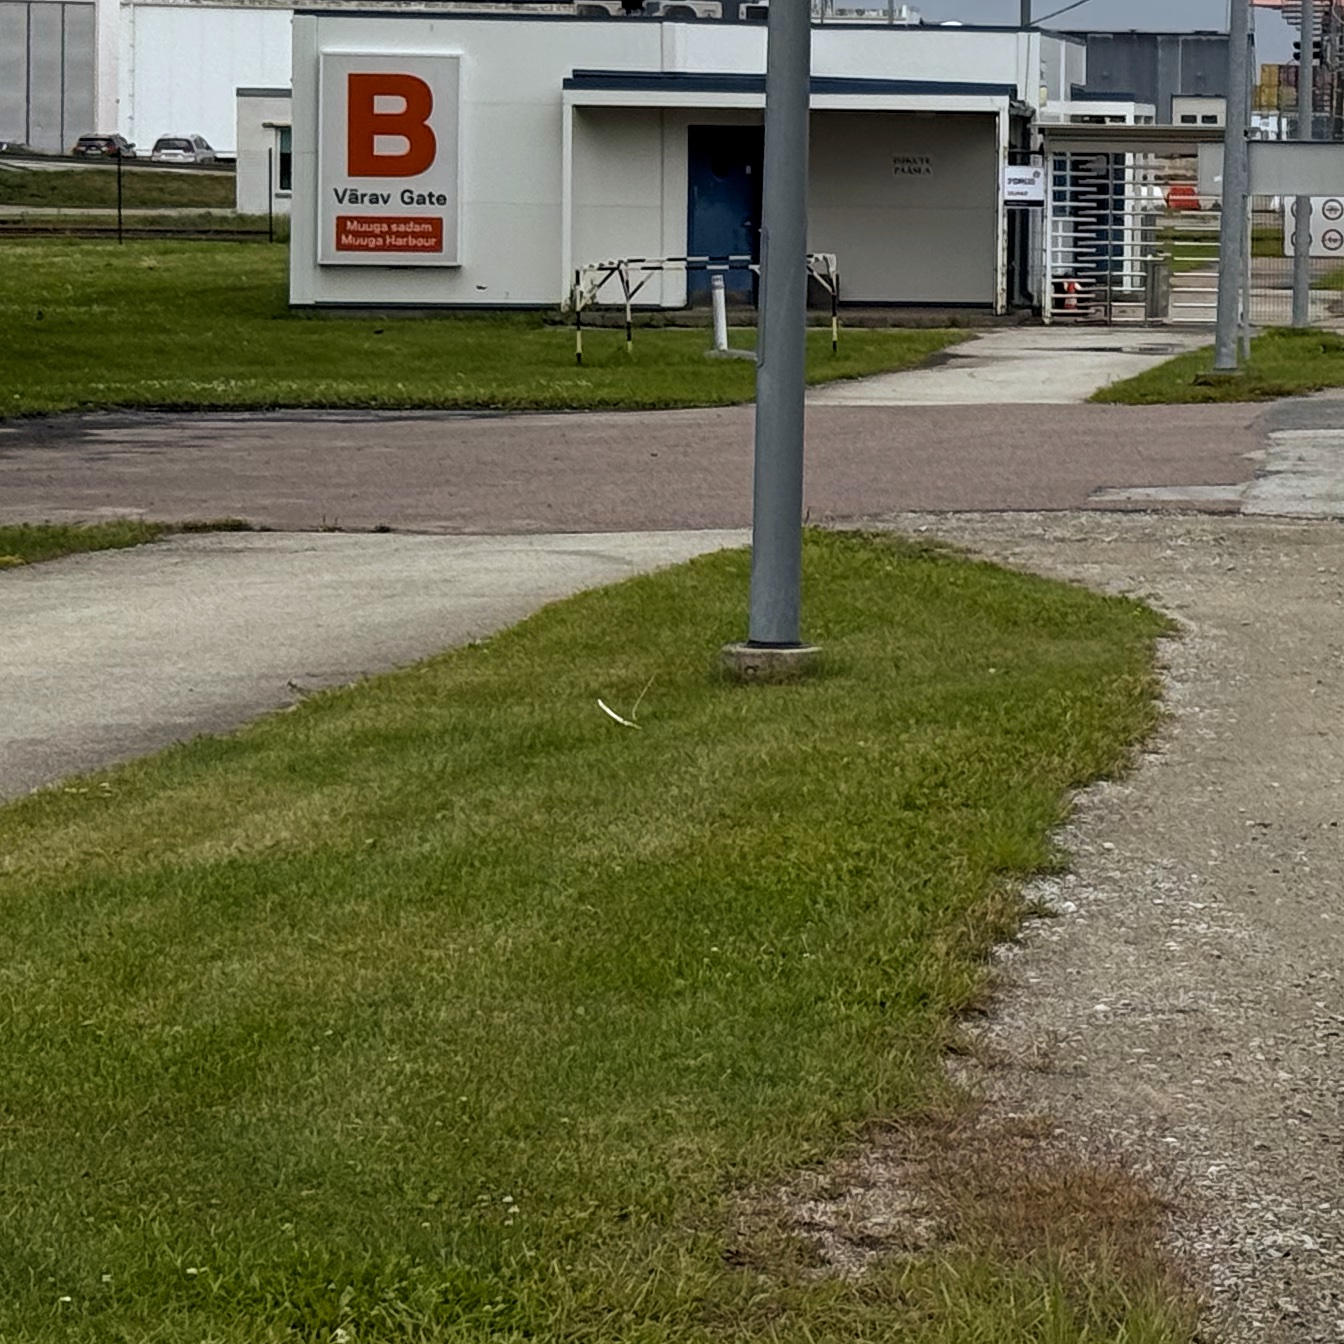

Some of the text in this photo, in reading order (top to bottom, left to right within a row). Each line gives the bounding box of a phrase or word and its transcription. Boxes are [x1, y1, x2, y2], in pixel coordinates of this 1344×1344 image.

[348, 73, 437, 177] B
[400, 189, 447, 206] Gate
[346, 220, 433, 234] Muuga sadam
[341, 234, 437, 248] Muuga Harbour
